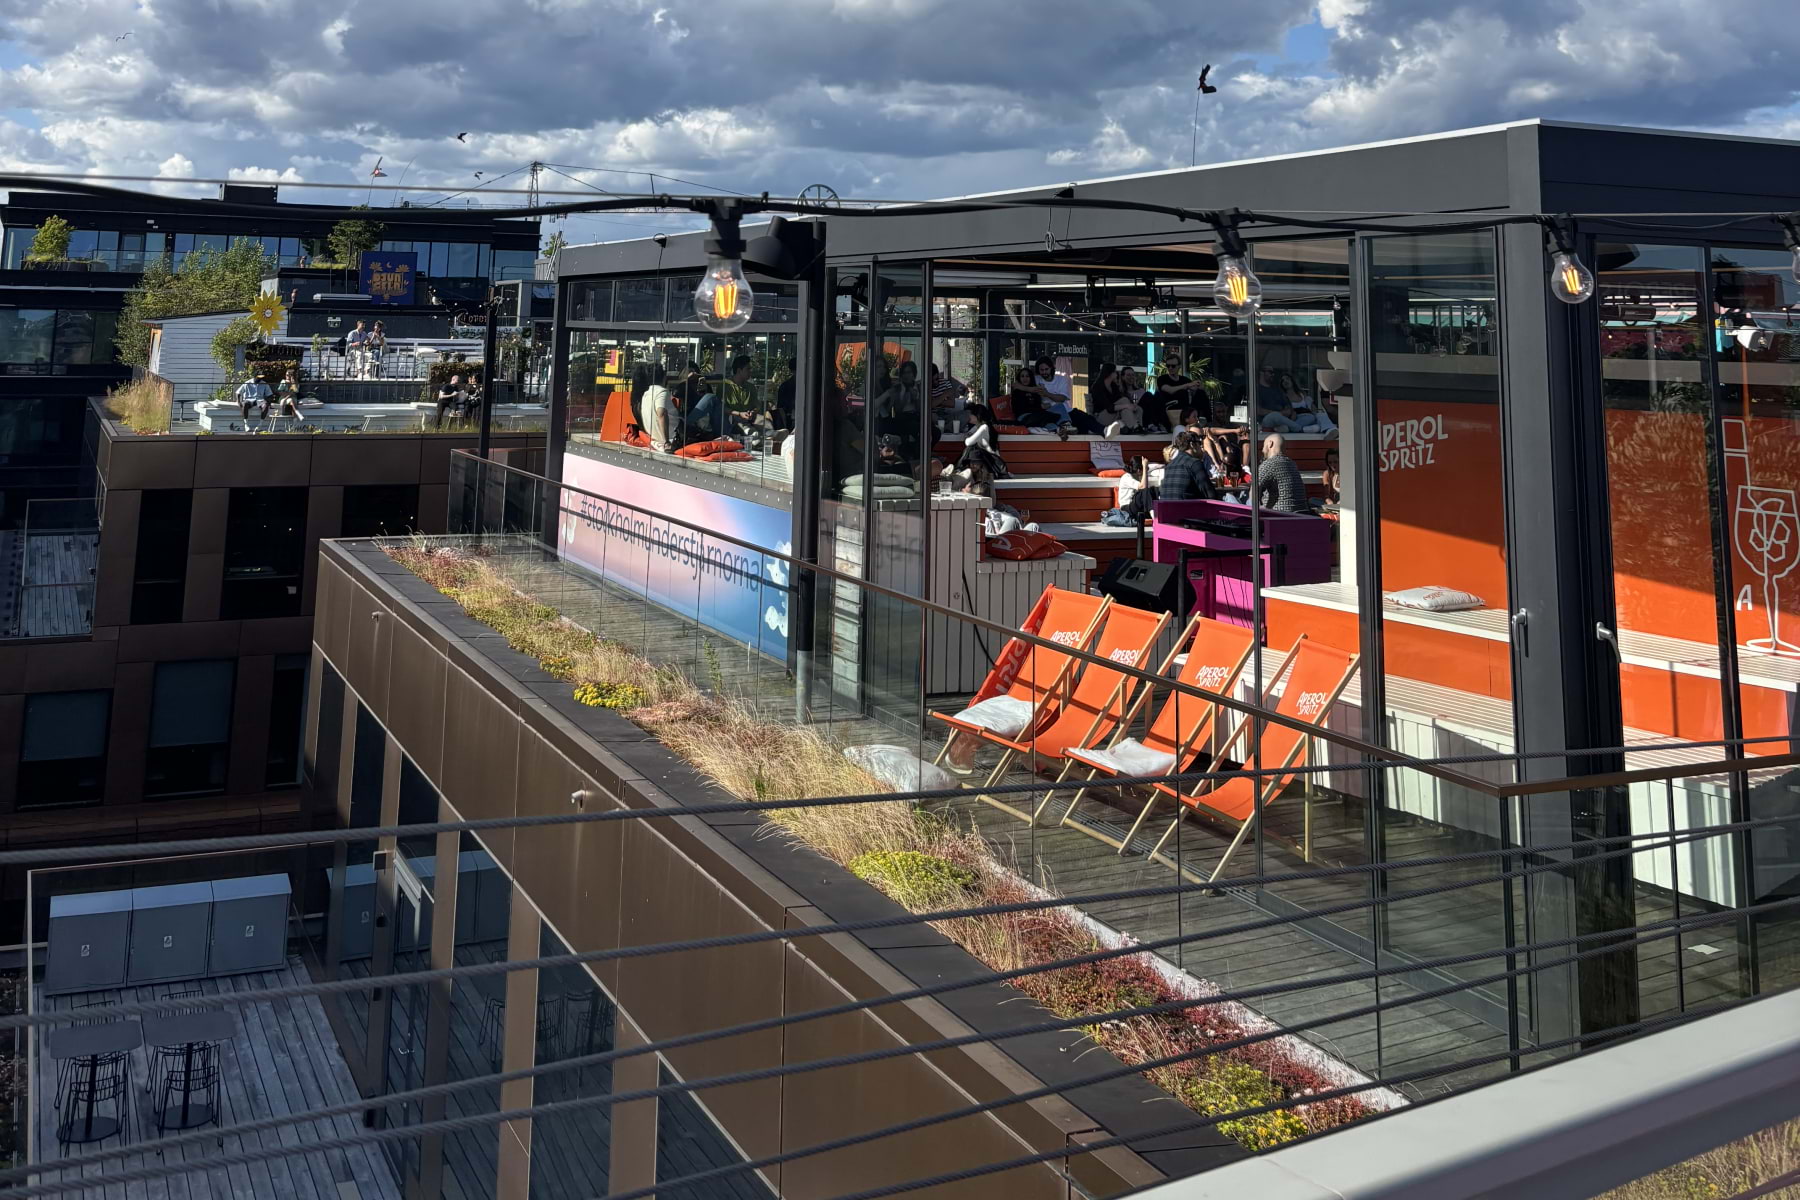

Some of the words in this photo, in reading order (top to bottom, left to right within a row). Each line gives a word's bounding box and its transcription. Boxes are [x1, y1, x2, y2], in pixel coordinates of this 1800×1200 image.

[1058, 343, 1072, 354] Photo
[1072, 344, 1088, 355] Booth
[1050, 630, 1081, 642] APEROL
[1109, 647, 1139, 661] APEROL
[1195, 665, 1229, 680] APEROL
[1296, 691, 1327, 707] APEROL
